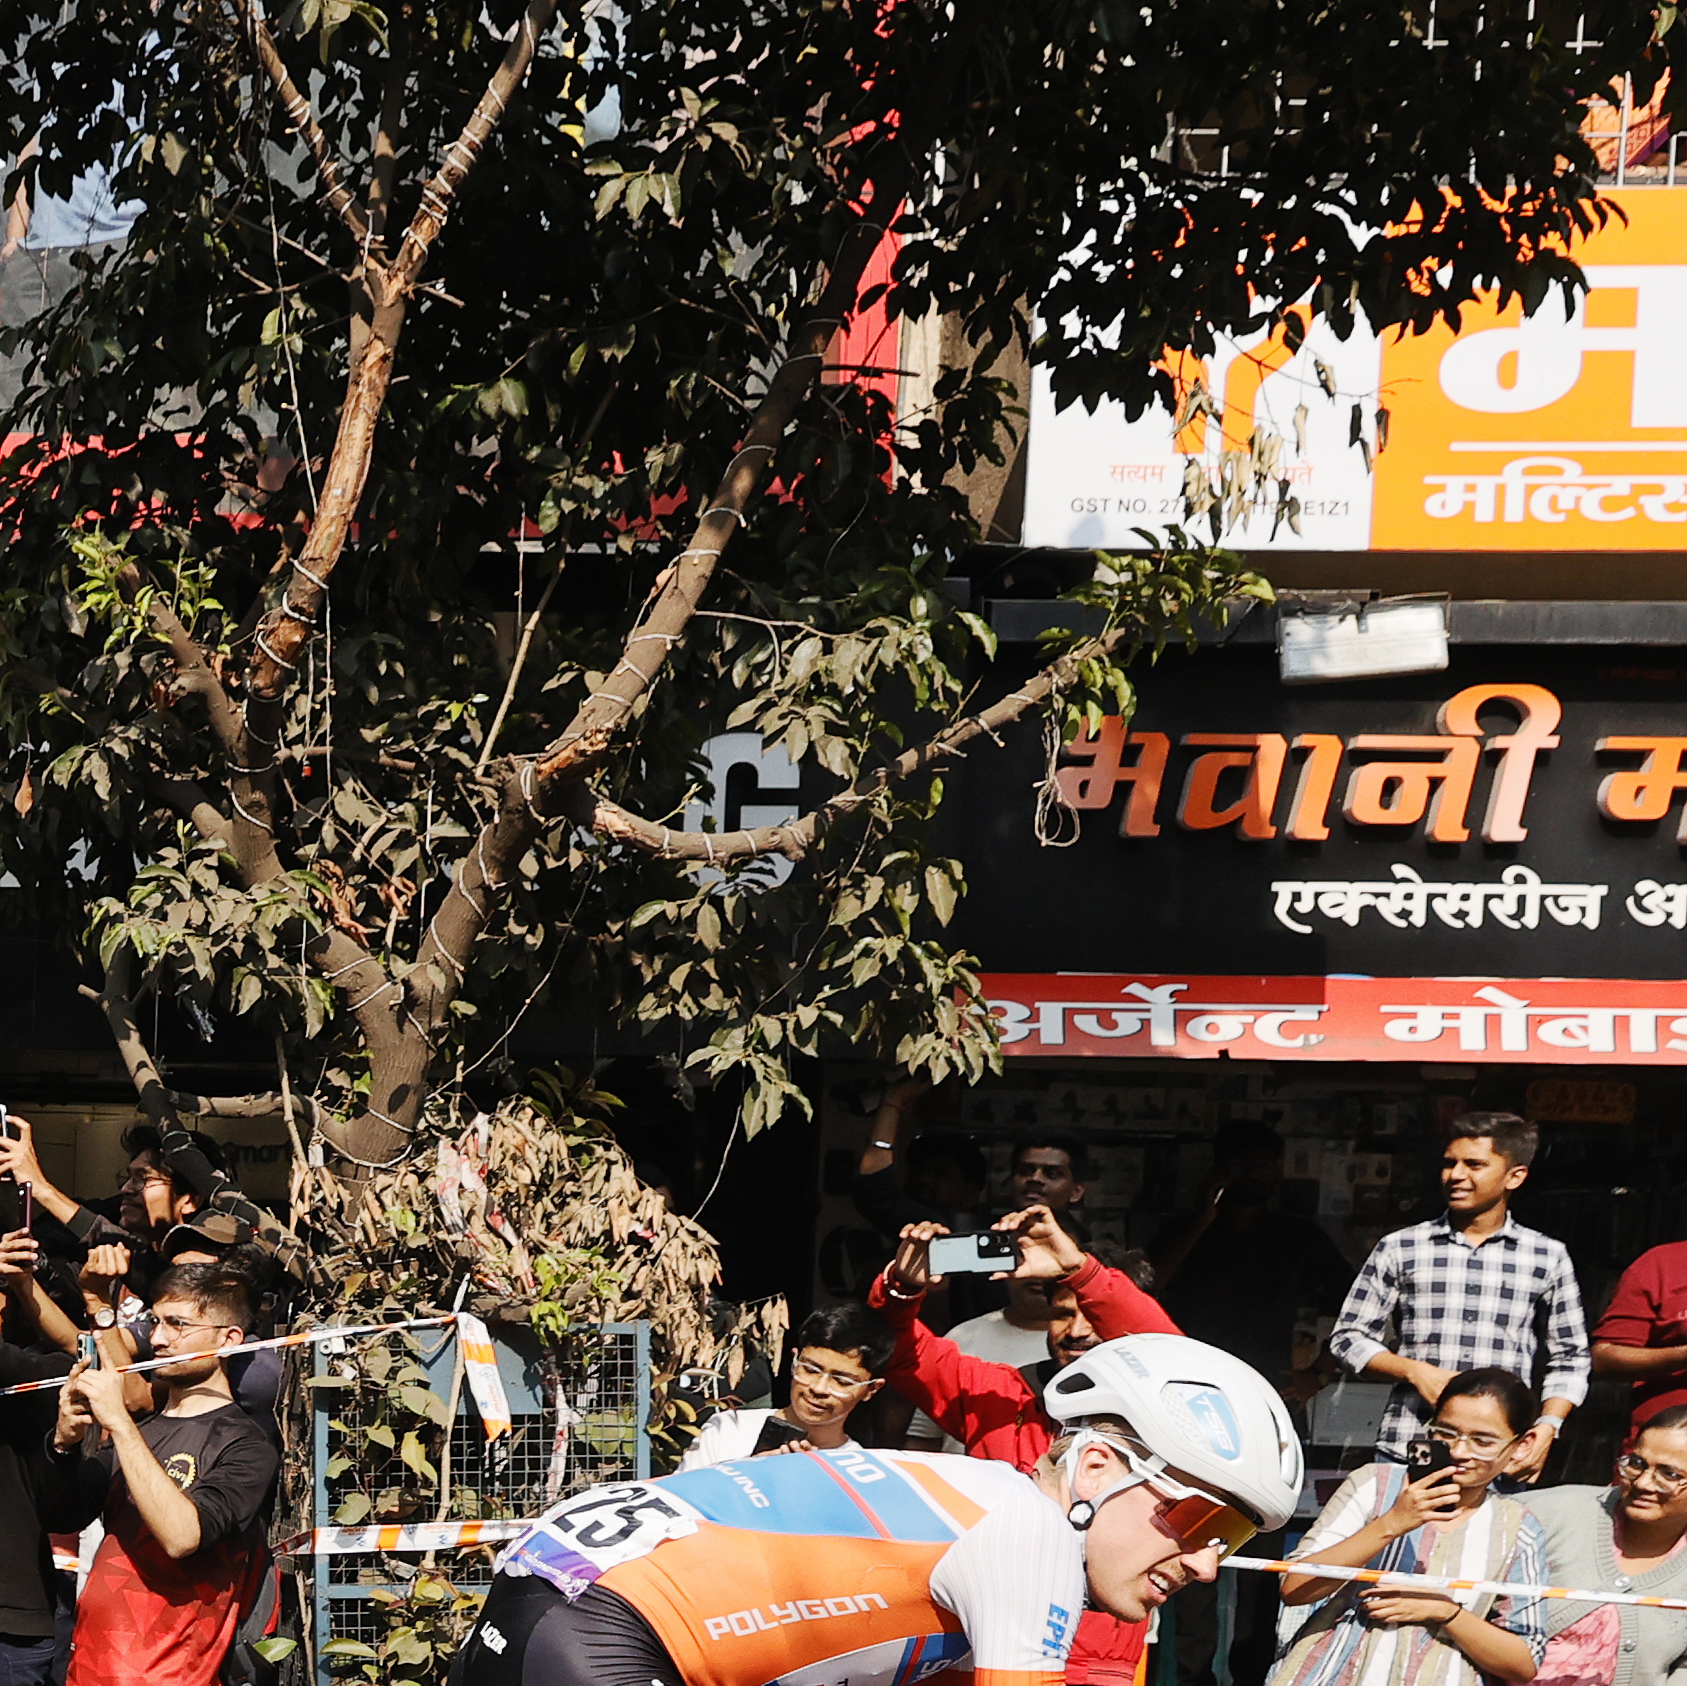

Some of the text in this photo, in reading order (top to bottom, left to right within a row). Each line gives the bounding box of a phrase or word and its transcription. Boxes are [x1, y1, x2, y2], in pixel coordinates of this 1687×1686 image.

[1071, 497, 1109, 515] GST
[1117, 499, 1152, 515] NO.
[1057, 683, 1562, 843] भवानी
[1272, 864, 1607, 934] एक्सेसरीज
[1112, 1346, 1151, 1380] LAZER
[1195, 1392, 1239, 1457] TSG
[480, 1621, 508, 1655] LAZER
[704, 1592, 889, 1641] POLYGON
